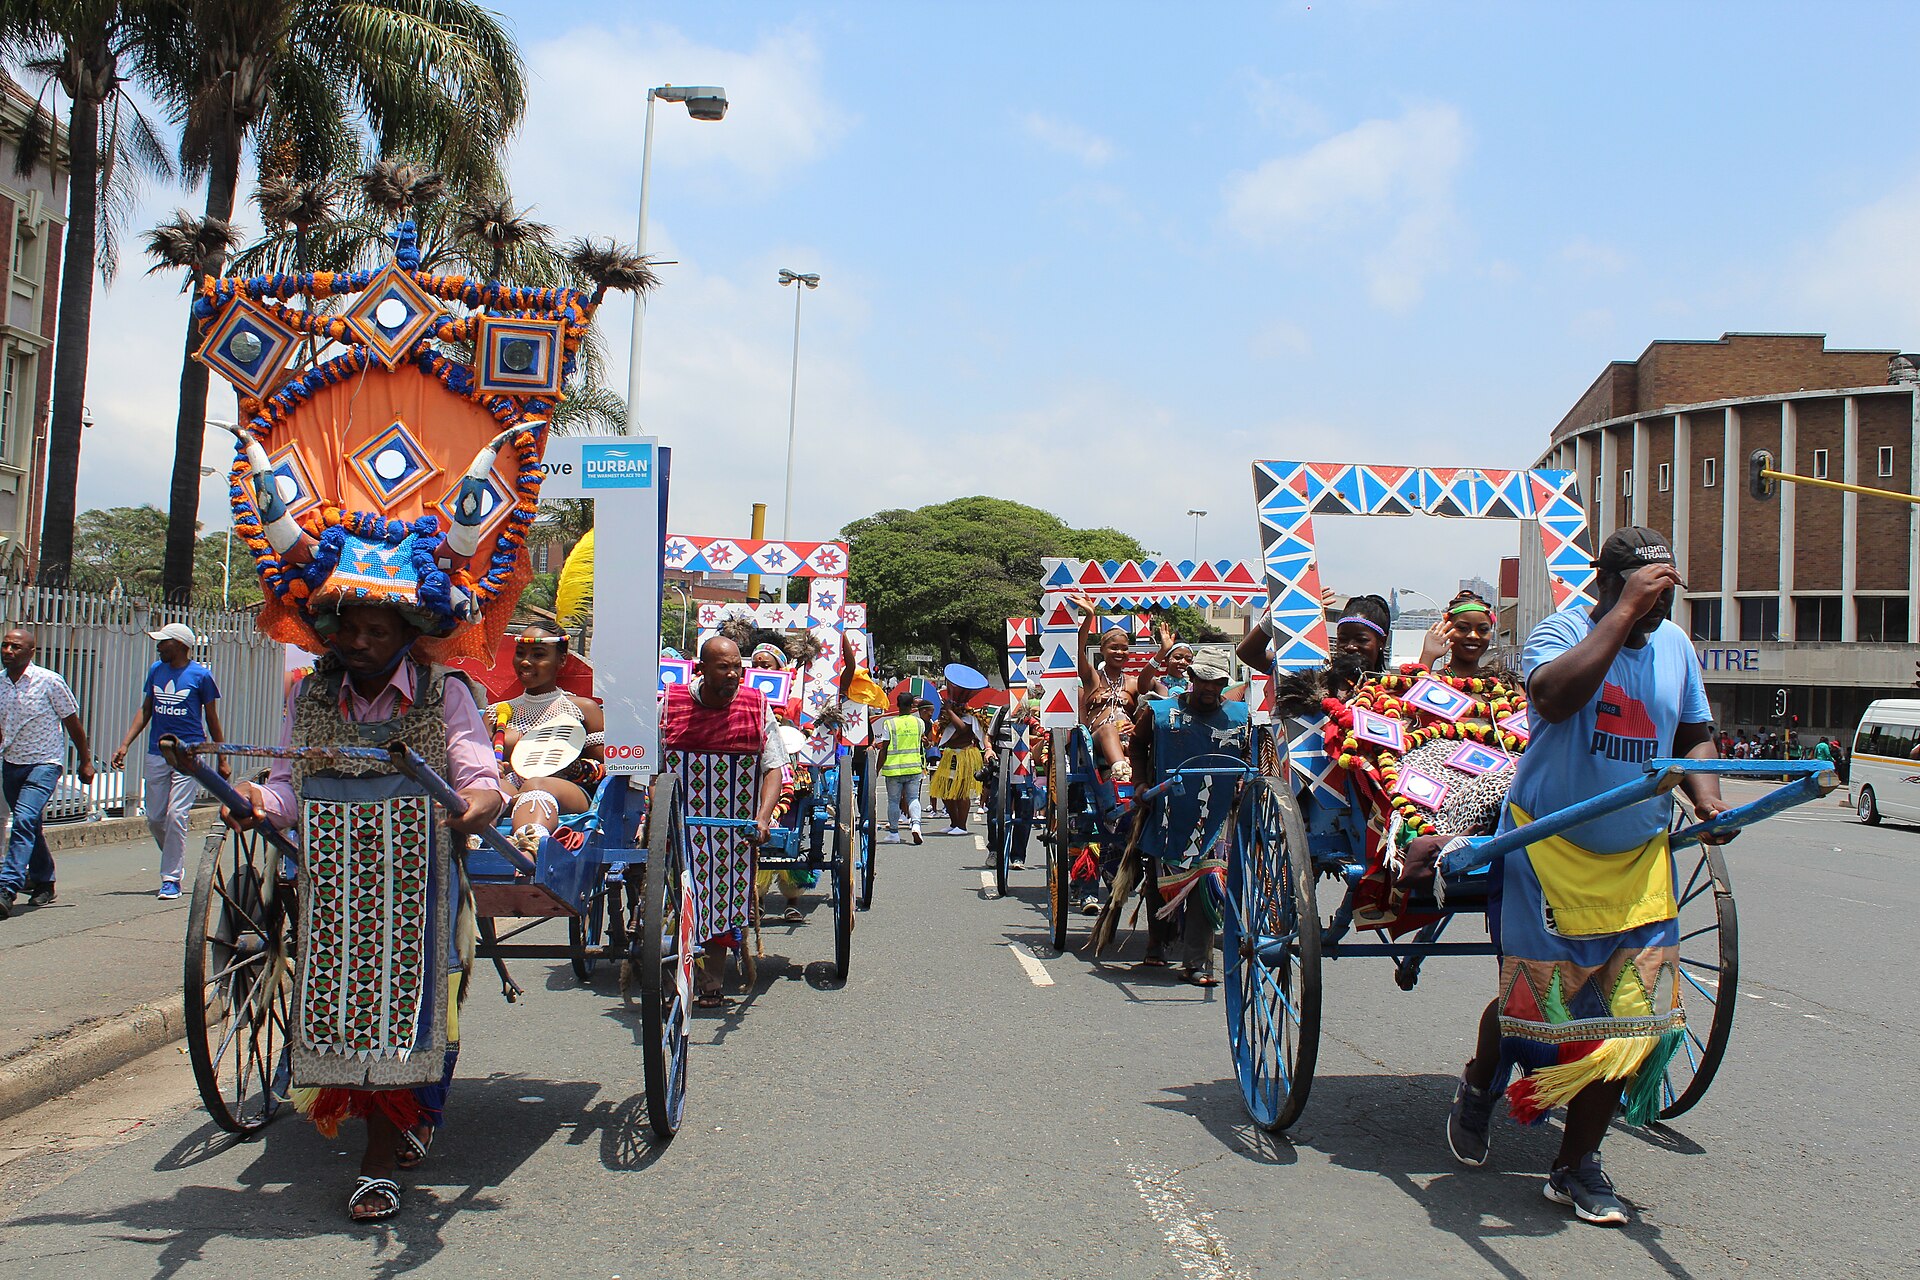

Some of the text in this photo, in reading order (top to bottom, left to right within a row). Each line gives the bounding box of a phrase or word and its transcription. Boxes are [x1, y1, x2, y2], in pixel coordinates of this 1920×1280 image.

[587, 460, 648, 472] DURBAN
[1635, 545, 1668, 555] MIGHTY
[1641, 551, 1671, 560] TRAINS
[1600, 703, 1617, 714] 1948
[1590, 731, 1659, 763] PUMA
